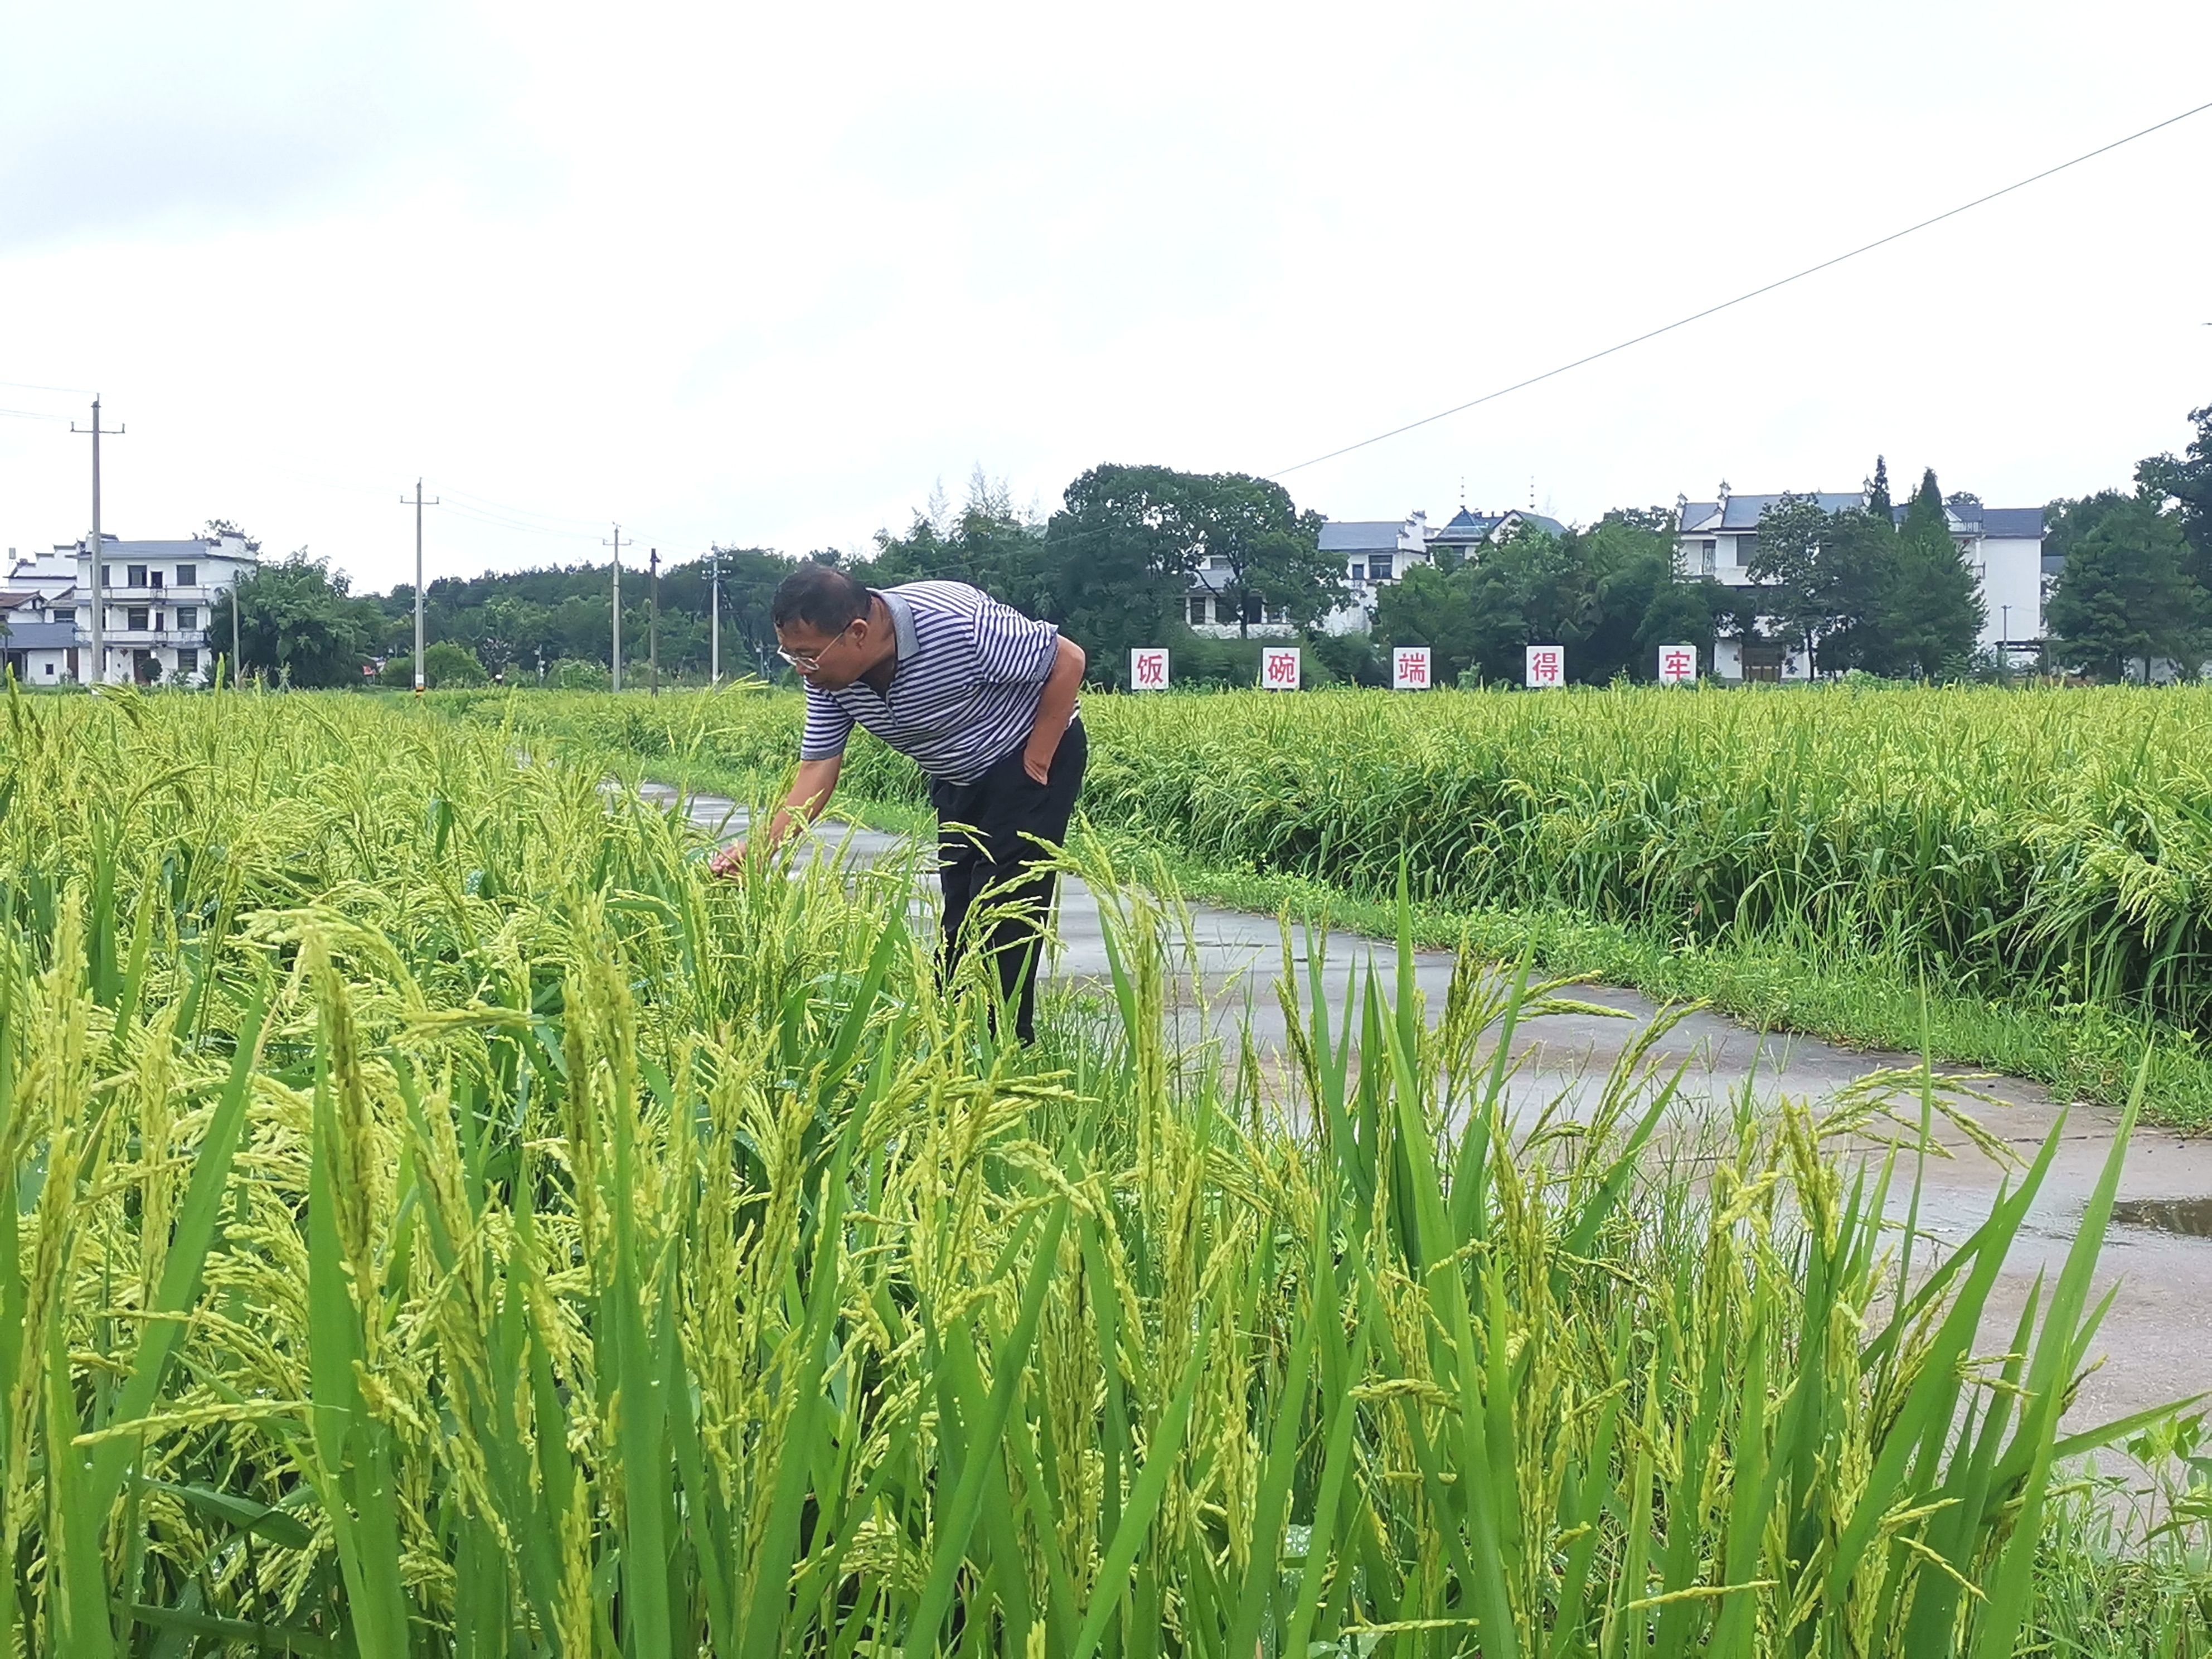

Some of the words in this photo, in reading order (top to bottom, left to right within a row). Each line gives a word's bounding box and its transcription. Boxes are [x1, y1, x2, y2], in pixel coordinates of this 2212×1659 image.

[1137, 655, 1162, 683] 饭
[1268, 653, 1295, 683] 碗
[1399, 653, 1425, 683] 端
[1533, 653, 1559, 681] 得
[1665, 651, 1691, 680] 牢
